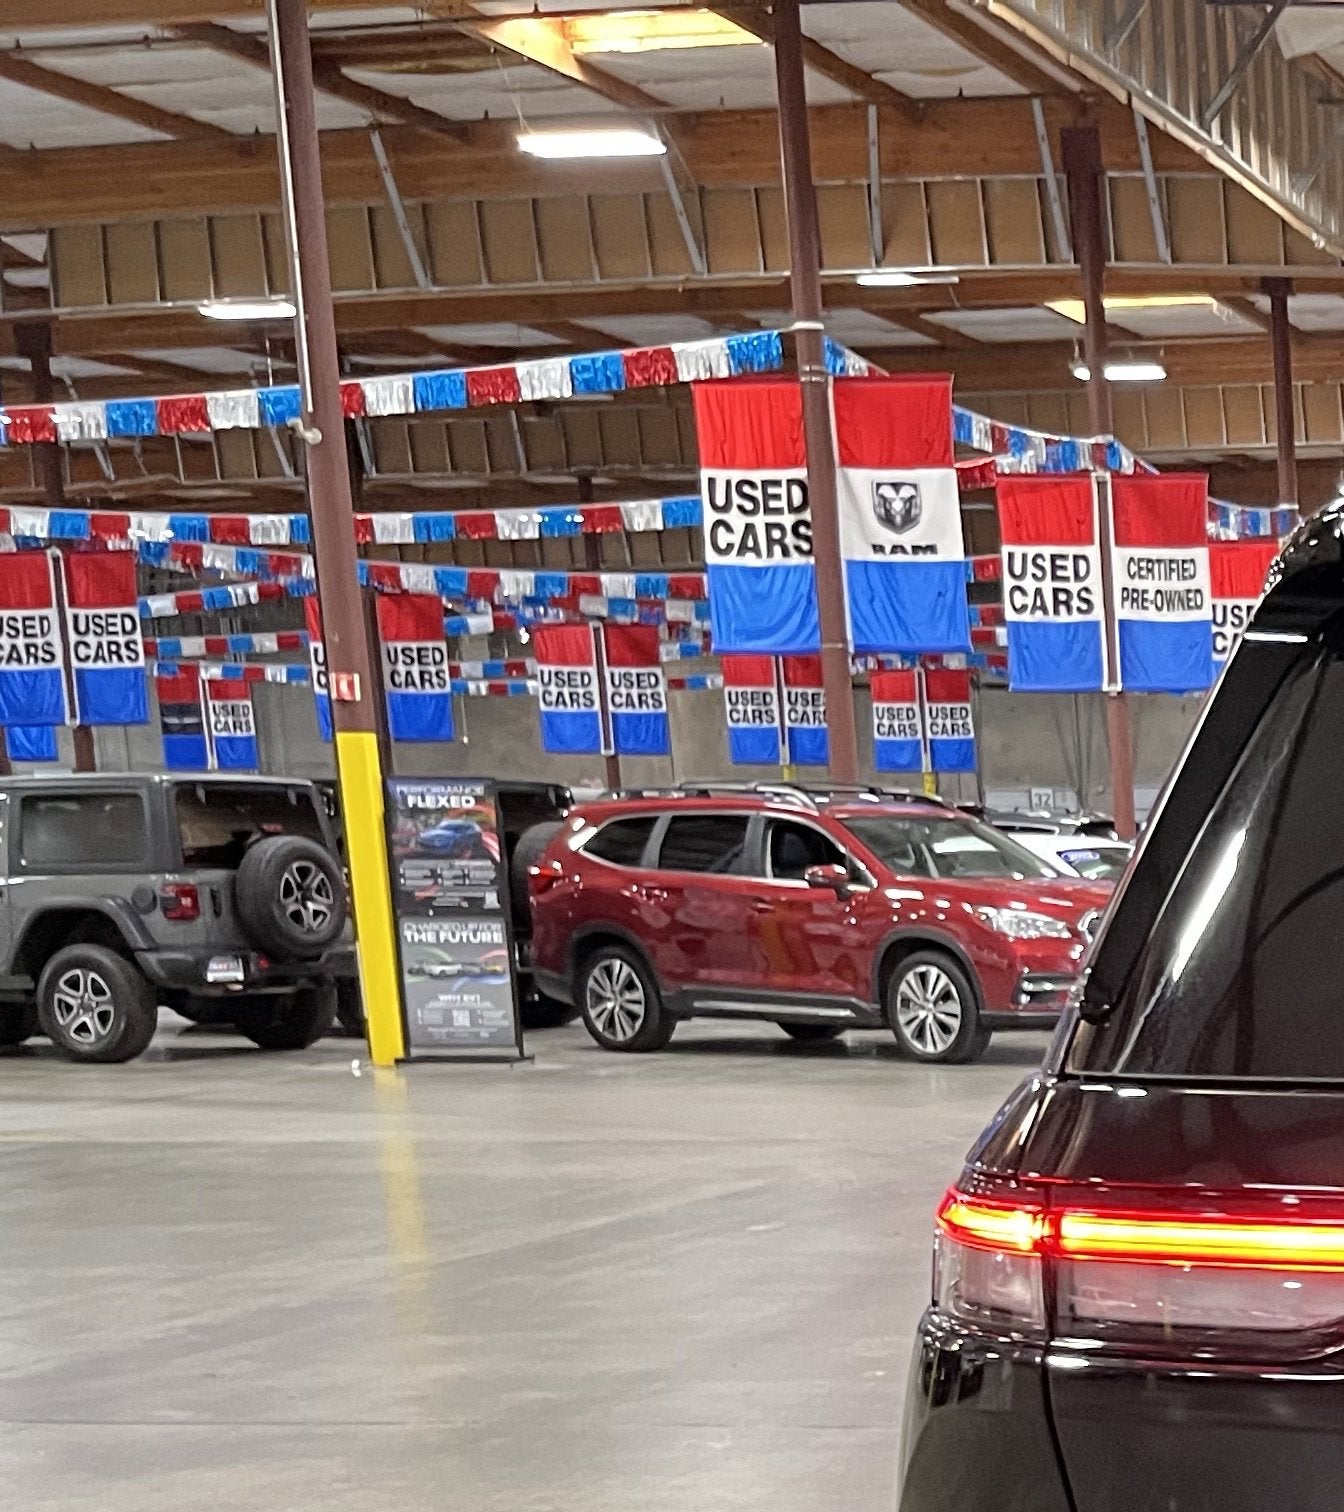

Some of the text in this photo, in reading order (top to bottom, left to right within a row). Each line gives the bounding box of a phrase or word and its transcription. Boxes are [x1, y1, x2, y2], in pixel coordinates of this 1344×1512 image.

[708, 476, 809, 517] USED
[710, 519, 813, 559] CARS
[871, 544, 938, 555] RAM
[1008, 552, 1090, 582] USED
[1127, 557, 1197, 581] CERTIFIED
[1009, 585, 1094, 616] CARS
[1121, 587, 1204, 612] PRE-OWNED
[73, 613, 137, 637] USED
[1212, 604, 1254, 628] US
[0, 615, 51, 639] SED
[74, 639, 140, 664] CARS
[387, 647, 444, 667] USED
[390, 668, 447, 689] CARS
[540, 670, 592, 688] USED
[610, 671, 660, 689] USED
[541, 690, 595, 709] CARS
[610, 691, 664, 709] CARS
[728, 690, 774, 707] USED
[787, 691, 825, 707] USE
[213, 703, 250, 717] USED
[729, 707, 776, 724] CARS
[787, 708, 827, 725] CAR
[875, 706, 916, 721] USED
[928, 706, 969, 721] USED
[213, 718, 252, 734] CARS
[876, 722, 918, 737] CARS
[928, 721, 971, 737] CARS
[407, 795, 476, 809] FLEXED
[404, 931, 503, 943] THE FUTURE
